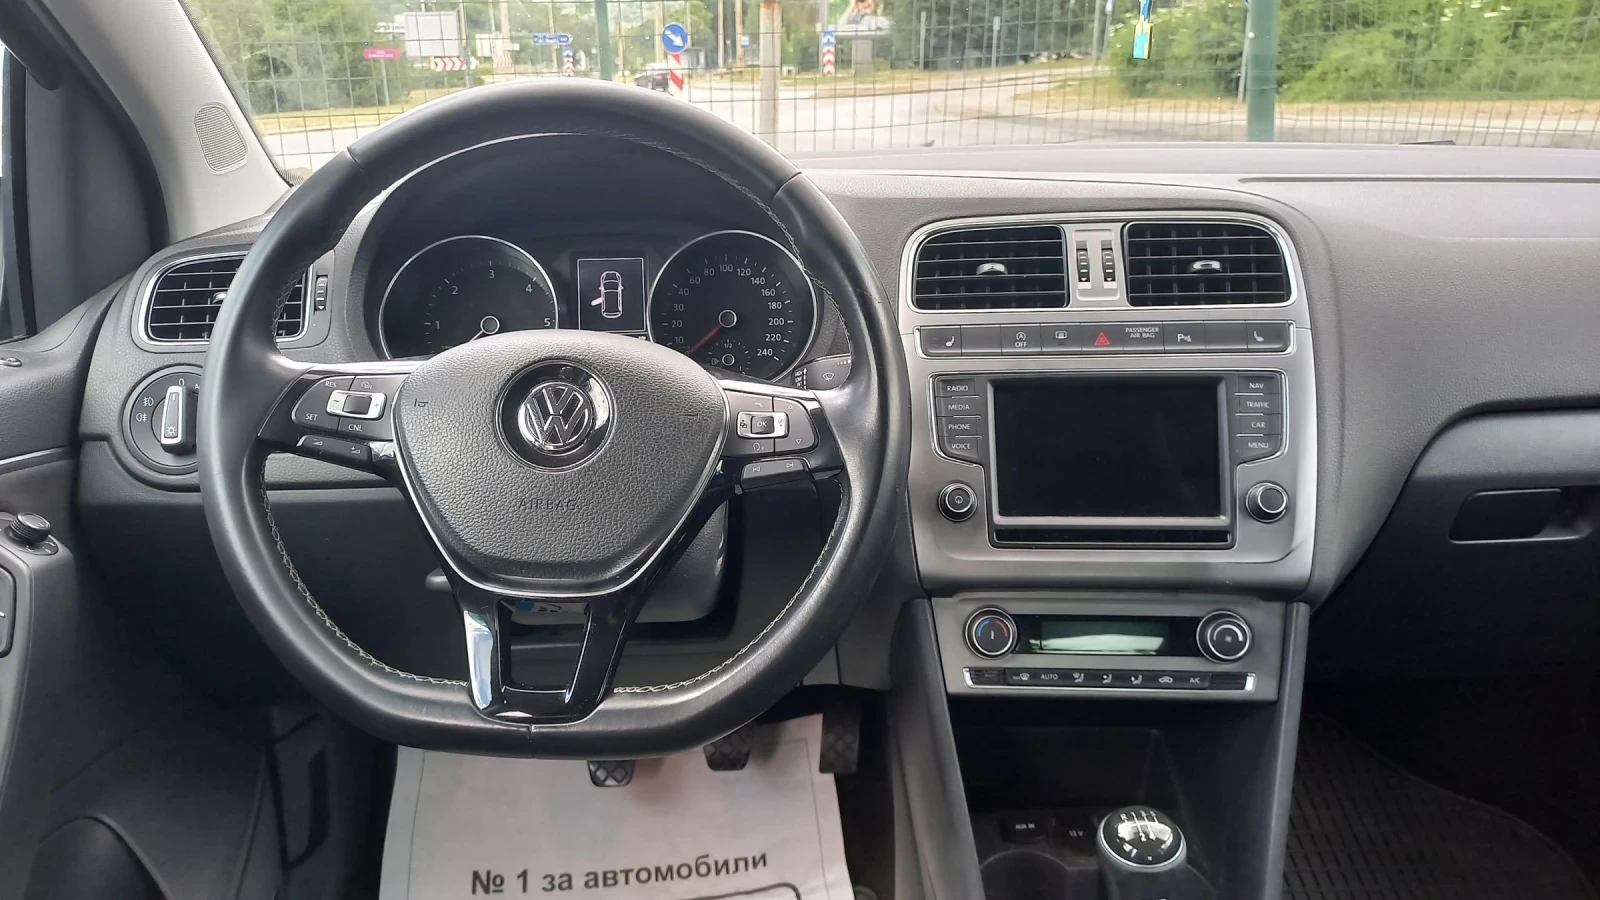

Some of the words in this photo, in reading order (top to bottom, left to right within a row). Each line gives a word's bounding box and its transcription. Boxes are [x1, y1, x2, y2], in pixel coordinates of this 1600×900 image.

[703, 268, 715, 277] 80
[718, 263, 734, 273] 100
[736, 267, 752, 277] 120
[488, 269, 495, 279] 3
[689, 276, 701, 285] 60
[750, 277, 766, 286] 140
[451, 285, 459, 295] 2
[525, 283, 533, 293] 4
[678, 287, 690, 297] 40
[761, 288, 776, 298] 160
[673, 303, 685, 312] 30
[767, 301, 783, 311] 180
[435, 320, 440, 330] 1
[543, 318, 551, 327] 5
[671, 319, 683, 328] 20
[768, 316, 785, 326] 200
[674, 336, 684, 344] 10
[765, 333, 782, 342] 220
[757, 348, 773, 357] 240
[325, 380, 337, 388] RES
[305, 413, 318, 421] SET
[348, 424, 363, 432] CNL
[518, 498, 577, 511] AIRBAG
[516, 869, 529, 893] 1
[541, 872, 573, 893] за
[584, 852, 767, 889] автомобили
